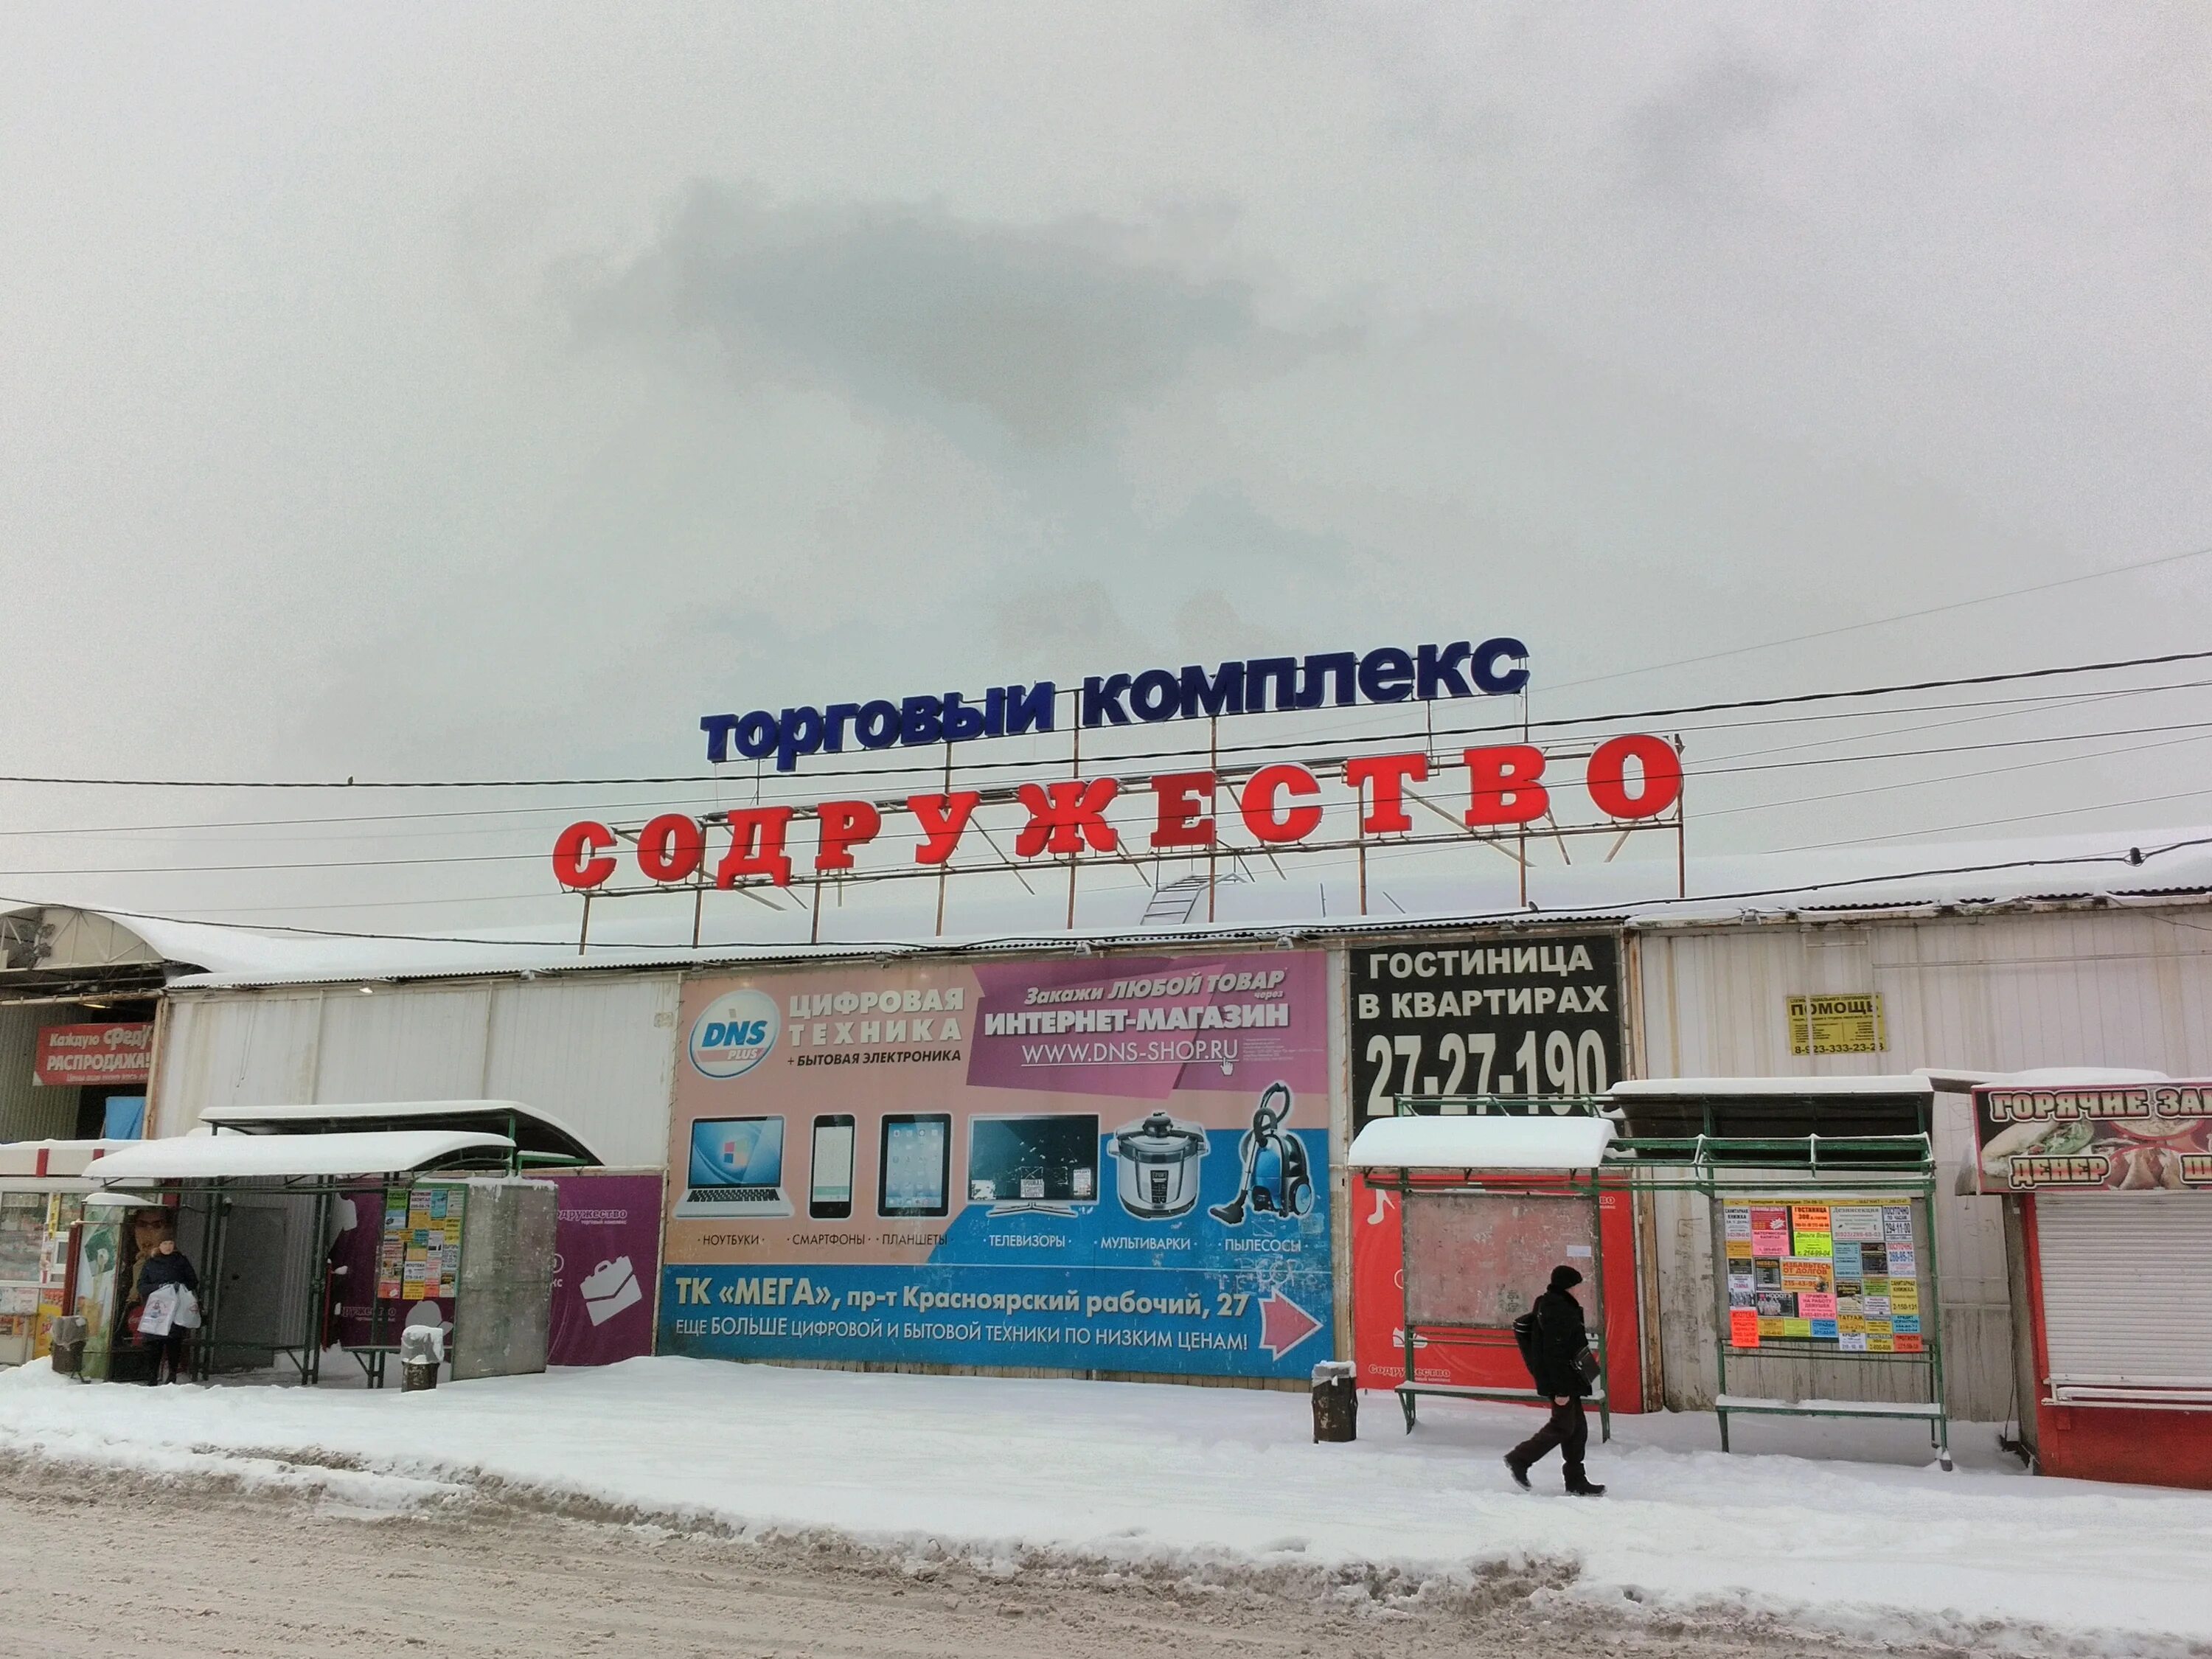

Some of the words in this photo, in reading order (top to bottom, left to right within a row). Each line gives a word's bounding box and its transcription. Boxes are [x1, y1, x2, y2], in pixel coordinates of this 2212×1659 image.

[552, 734, 1683, 890] СОДРУЖЕСТВО
[1369, 945, 1593, 980] ГОСТИНИЦА
[1024, 987, 1105, 1006] Закажи
[1107, 972, 1203, 1000] ЛЮБОЙ
[1253, 991, 1284, 1001] через
[1358, 993, 1380, 1019] В
[1391, 985, 1609, 1018] КВАРТИРАХ
[789, 987, 964, 1020] ЦИФРОВАЯ
[1790, 1001, 1879, 1016] ПОМОЩЬ
[788, 1018, 961, 1047] ТЕХНИКА
[984, 1003, 1290, 1037] ИНТЕРНЕТ-МАГАЗИН
[49, 1032, 100, 1050] Каждую
[103, 1025, 154, 1051] среду
[701, 1020, 768, 1048] DNS
[46, 1052, 152, 1071] РАСПРОДАЖА!
[727, 1048, 759, 1061] PLUS
[796, 1051, 860, 1067] БЫТОВАЯ
[863, 1049, 961, 1064] ЭЛЕКТРОНИКА
[1021, 1039, 1239, 1065] WWW.DNS-SHOP.RU
[1366, 1029, 1608, 1116] 27-27-190
[1990, 1088, 2150, 1121] ГОРЯЧИЕ
[2009, 1155, 2110, 1190] ДЕНЕР
[557, 1209, 628, 1222] дружество
[703, 1234, 760, 1246] НОУТБУКИ
[792, 1234, 866, 1246] СМАРТФОНЫ
[882, 1234, 948, 1246] ПЛАНШЕТЫ
[989, 1234, 1066, 1248] ТЕЛЕВИЗОРЫ
[1100, 1237, 1191, 1251] МУЛЬТИВАРКИ
[1224, 1239, 1301, 1253] ПЫЛЕСОСЫ
[1783, 1262, 1831, 1270] ИЗБАВЬТЕСЬ
[675, 1277, 713, 1305] ТК
[718, 1277, 841, 1312] «МЕГА»,
[847, 1290, 897, 1312] пр-т
[903, 1285, 1080, 1315] Красноярский
[1086, 1290, 1210, 1318] рабочий,
[1217, 1293, 1251, 1317] 27
[675, 1318, 708, 1337] ЕЩЕ
[711, 1317, 787, 1336] БОЛЬШЕ
[792, 1318, 883, 1339] ЦИФРОВОЙ
[887, 1324, 899, 1338] И
[904, 1321, 981, 1341] БЫТОВОЙ
[985, 1324, 1060, 1343] ТЕХНИКИ
[1065, 1328, 1091, 1345] ПО
[1096, 1329, 1172, 1348] НИЗКИМ
[1178, 1332, 1249, 1352] ЦЕНАМ!
[1368, 1363, 1451, 1378] Содруество
